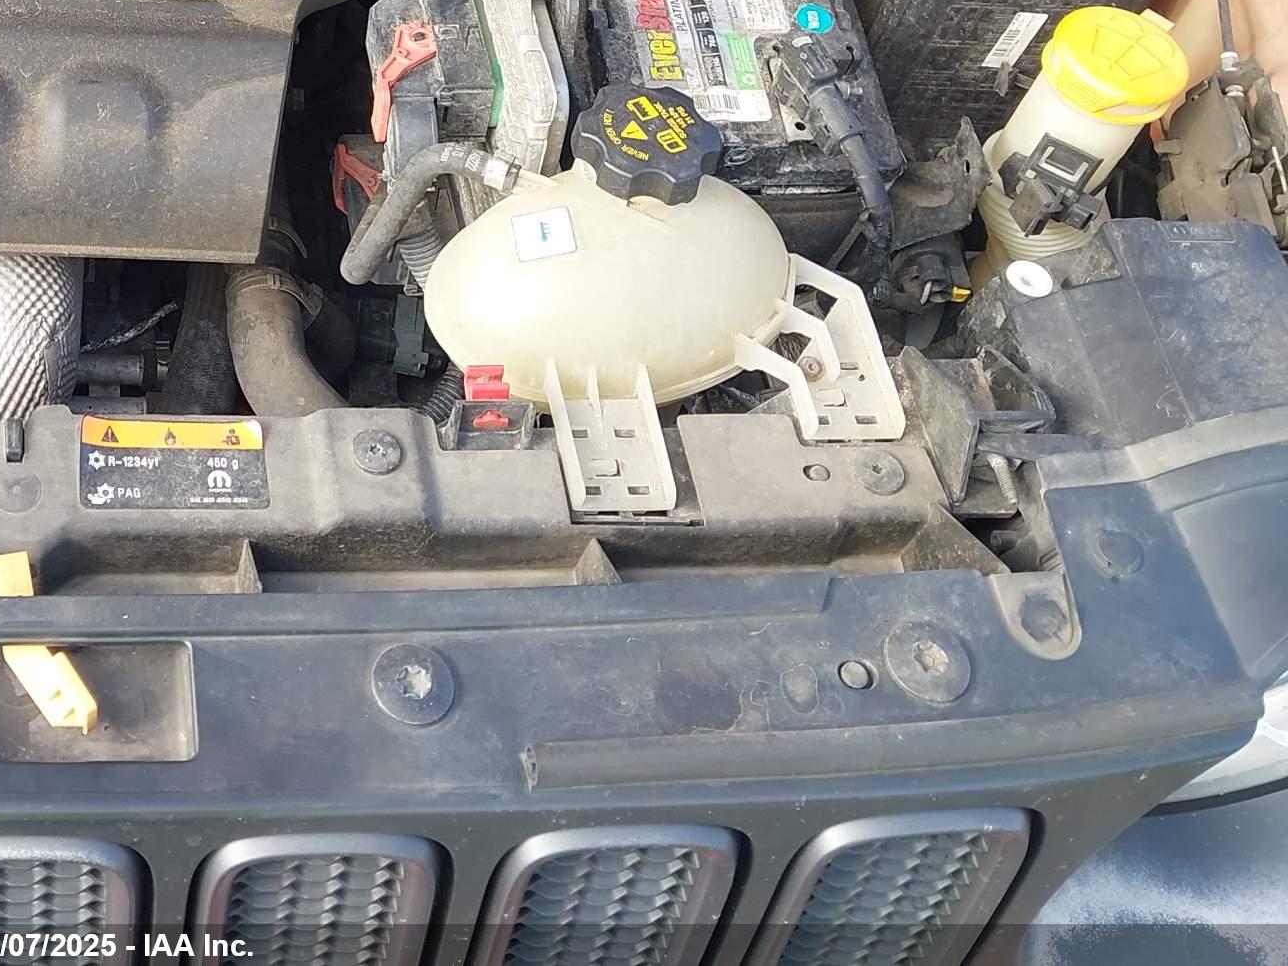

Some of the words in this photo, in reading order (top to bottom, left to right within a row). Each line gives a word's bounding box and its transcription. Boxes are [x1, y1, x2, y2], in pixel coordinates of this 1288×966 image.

[653, 101, 670, 119] TANK
[676, 106, 688, 118] PSI
[605, 127, 621, 145] OPEN
[666, 117, 687, 139] SURGE
[621, 144, 649, 161] NEVER
[206, 457, 228, 468] 450
[232, 459, 239, 470] g
[117, 487, 141, 499] PAG
